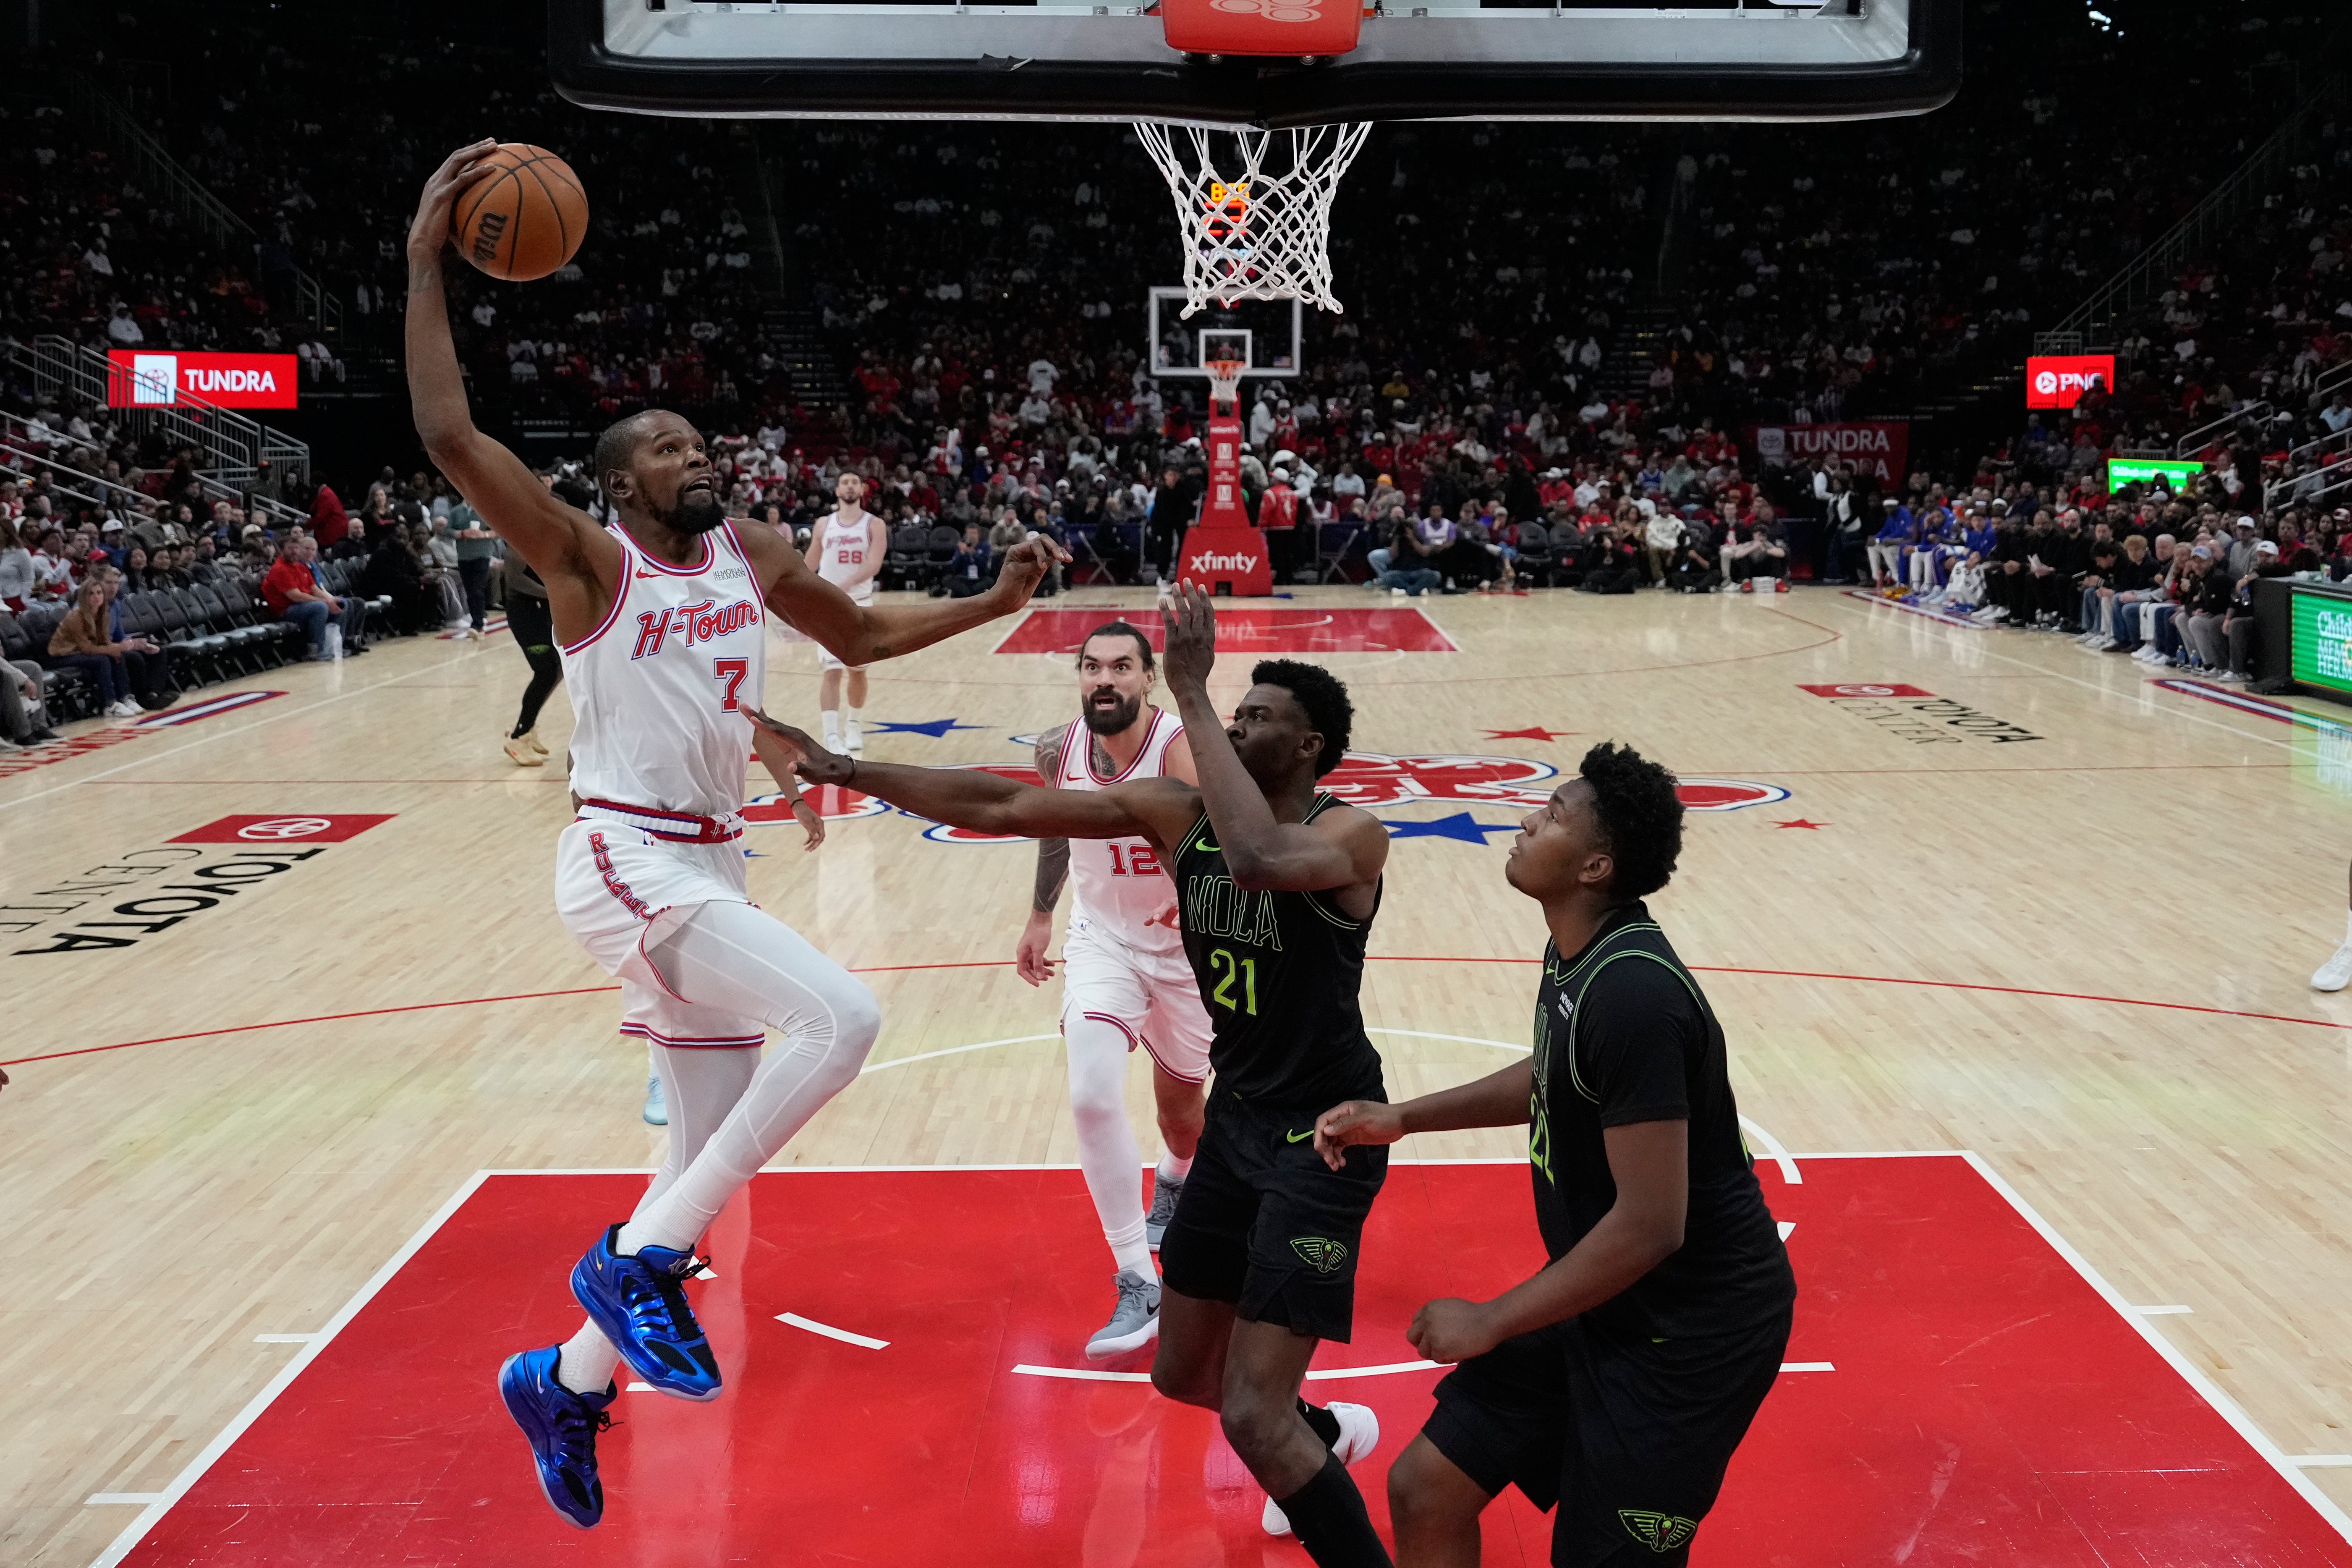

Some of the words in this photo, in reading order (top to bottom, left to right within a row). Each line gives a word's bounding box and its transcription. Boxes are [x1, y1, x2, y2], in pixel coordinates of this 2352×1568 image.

[184, 369, 276, 392] TUNDRA
[1789, 429, 1890, 453] TUNDRA
[713, 566, 744, 577] MEMORIAL
[714, 571, 746, 581] HERMANN
[838, 550, 863, 564] 28
[1190, 550, 1258, 574] xfinity
[631, 599, 759, 660] H-Town
[714, 657, 748, 713] 7
[1829, 699, 1963, 744] CENTER
[1899, 698, 2046, 743] TOYOTA
[1107, 842, 1164, 877] 12
[9, 848, 328, 956] TOYOTA
[1187, 876, 1282, 951] NOLA
[1211, 948, 1257, 1016] 21
